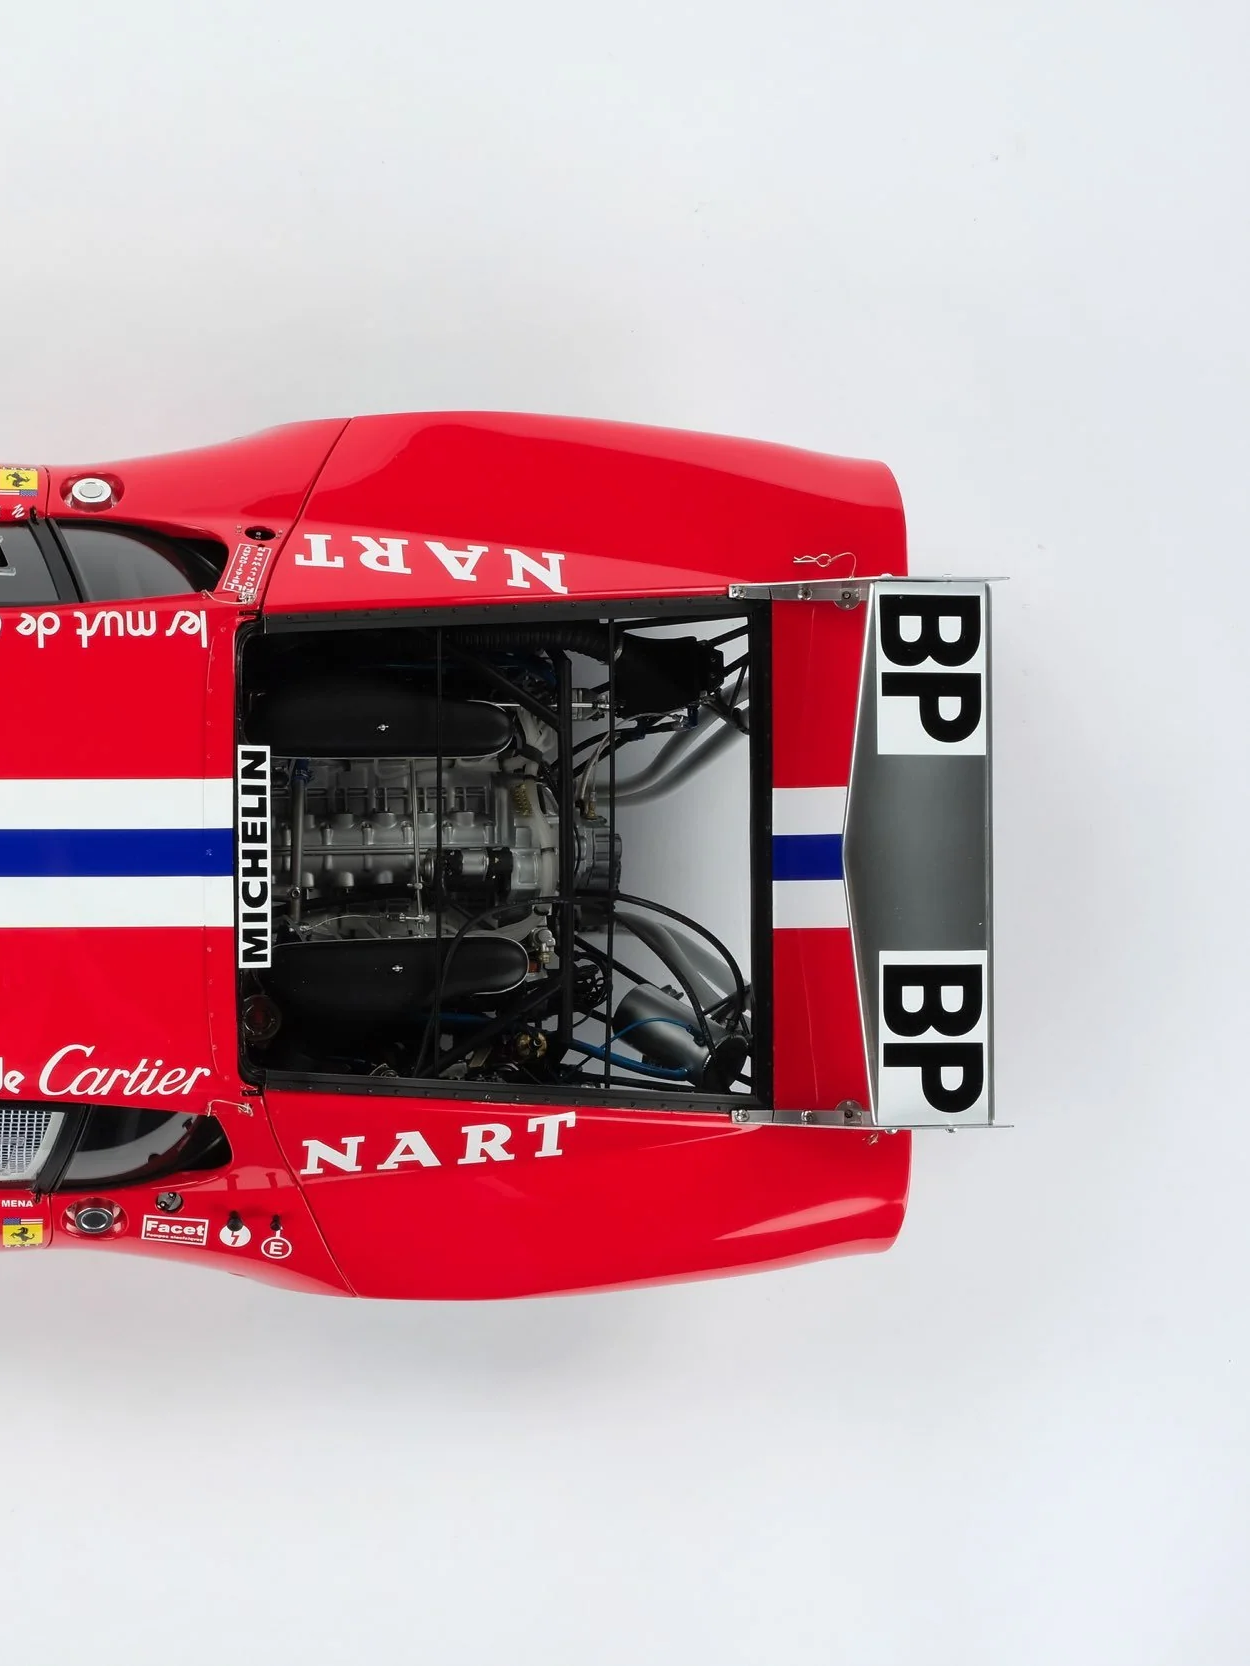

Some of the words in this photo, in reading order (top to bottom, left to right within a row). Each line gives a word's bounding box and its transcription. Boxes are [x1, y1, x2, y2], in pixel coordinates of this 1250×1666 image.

[294, 533, 569, 595] NART
[18, 611, 61, 649] de
[73, 610, 157, 649] must
[165, 610, 208, 649] les
[880, 594, 982, 744] BP
[240, 750, 269, 963] MICHELIN
[883, 964, 984, 1114] BP
[38, 1044, 211, 1096] Cartier
[299, 1111, 577, 1175] NART
[1, 1199, 34, 1209] MENA
[146, 1220, 205, 1237] Facet
[269, 1241, 284, 1255] E
